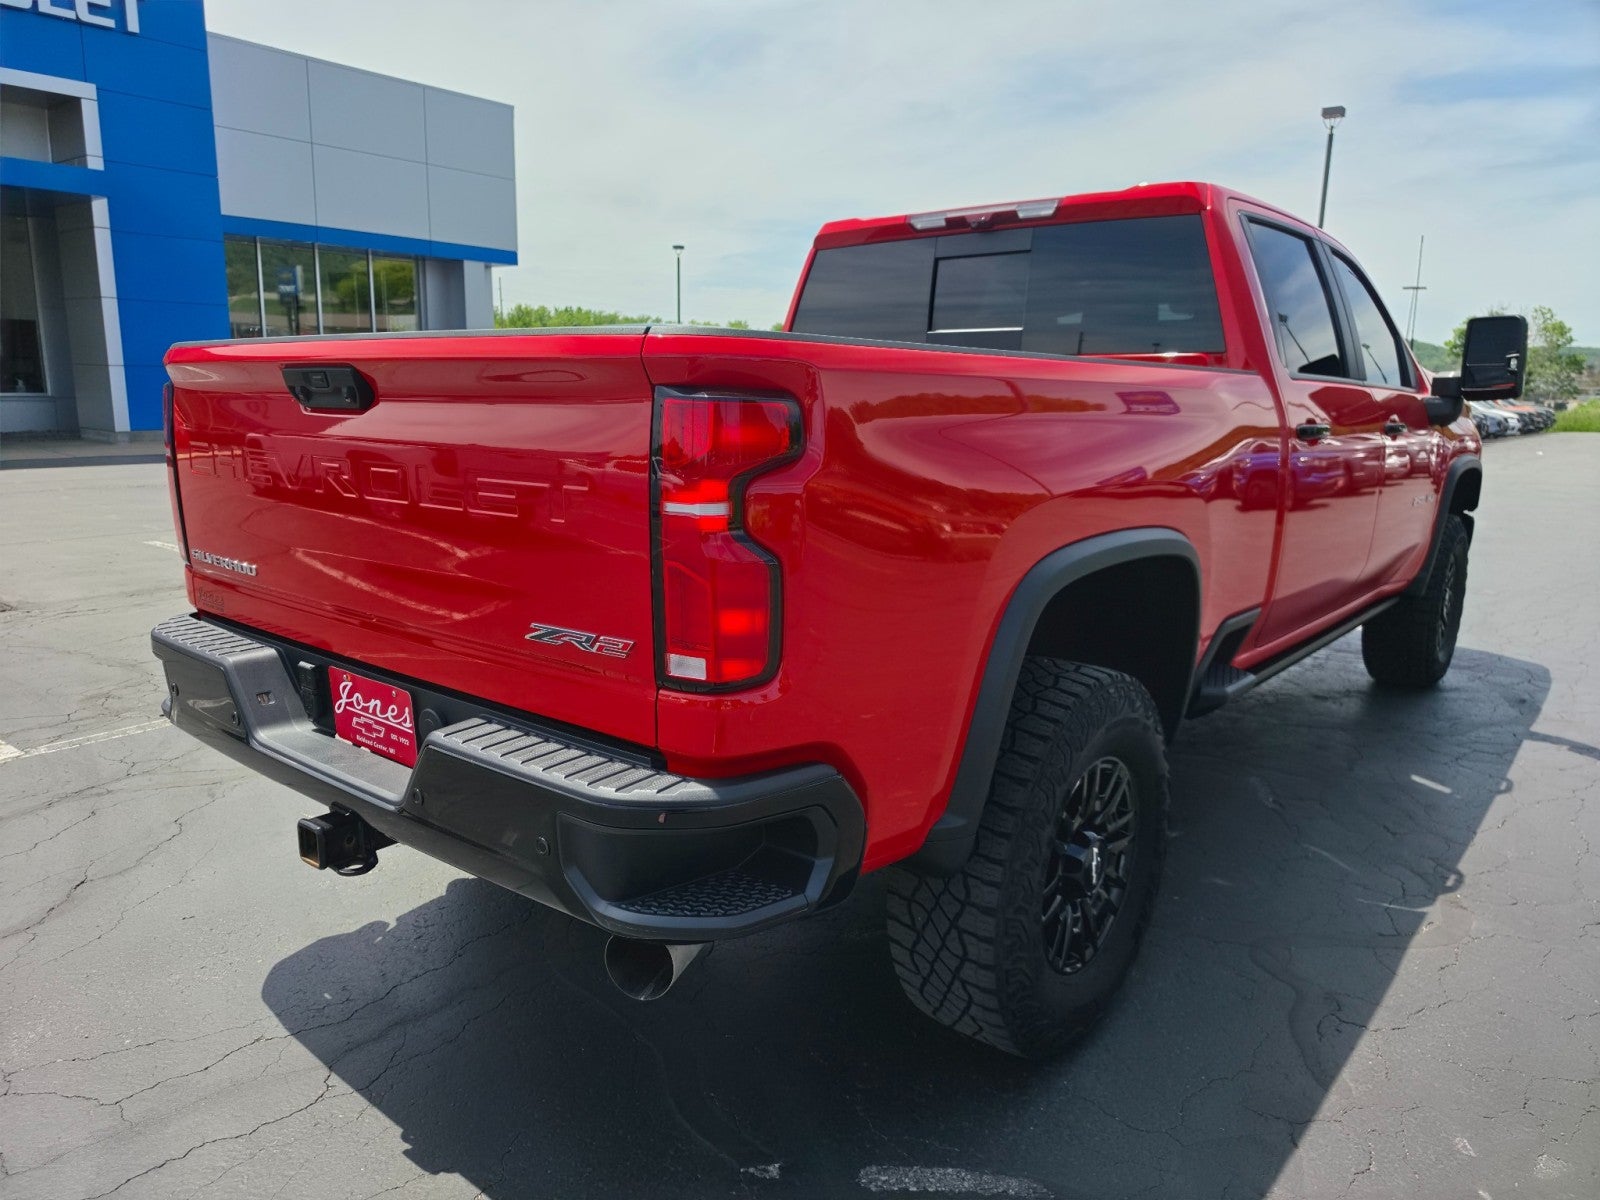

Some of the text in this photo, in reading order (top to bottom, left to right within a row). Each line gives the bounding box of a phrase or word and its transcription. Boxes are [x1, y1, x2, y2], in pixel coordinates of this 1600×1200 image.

[188, 440, 591, 524] CHEVROLET
[192, 549, 257, 576] SILVERADO
[524, 622, 635, 659] ZR2
[334, 681, 412, 727] Jones
